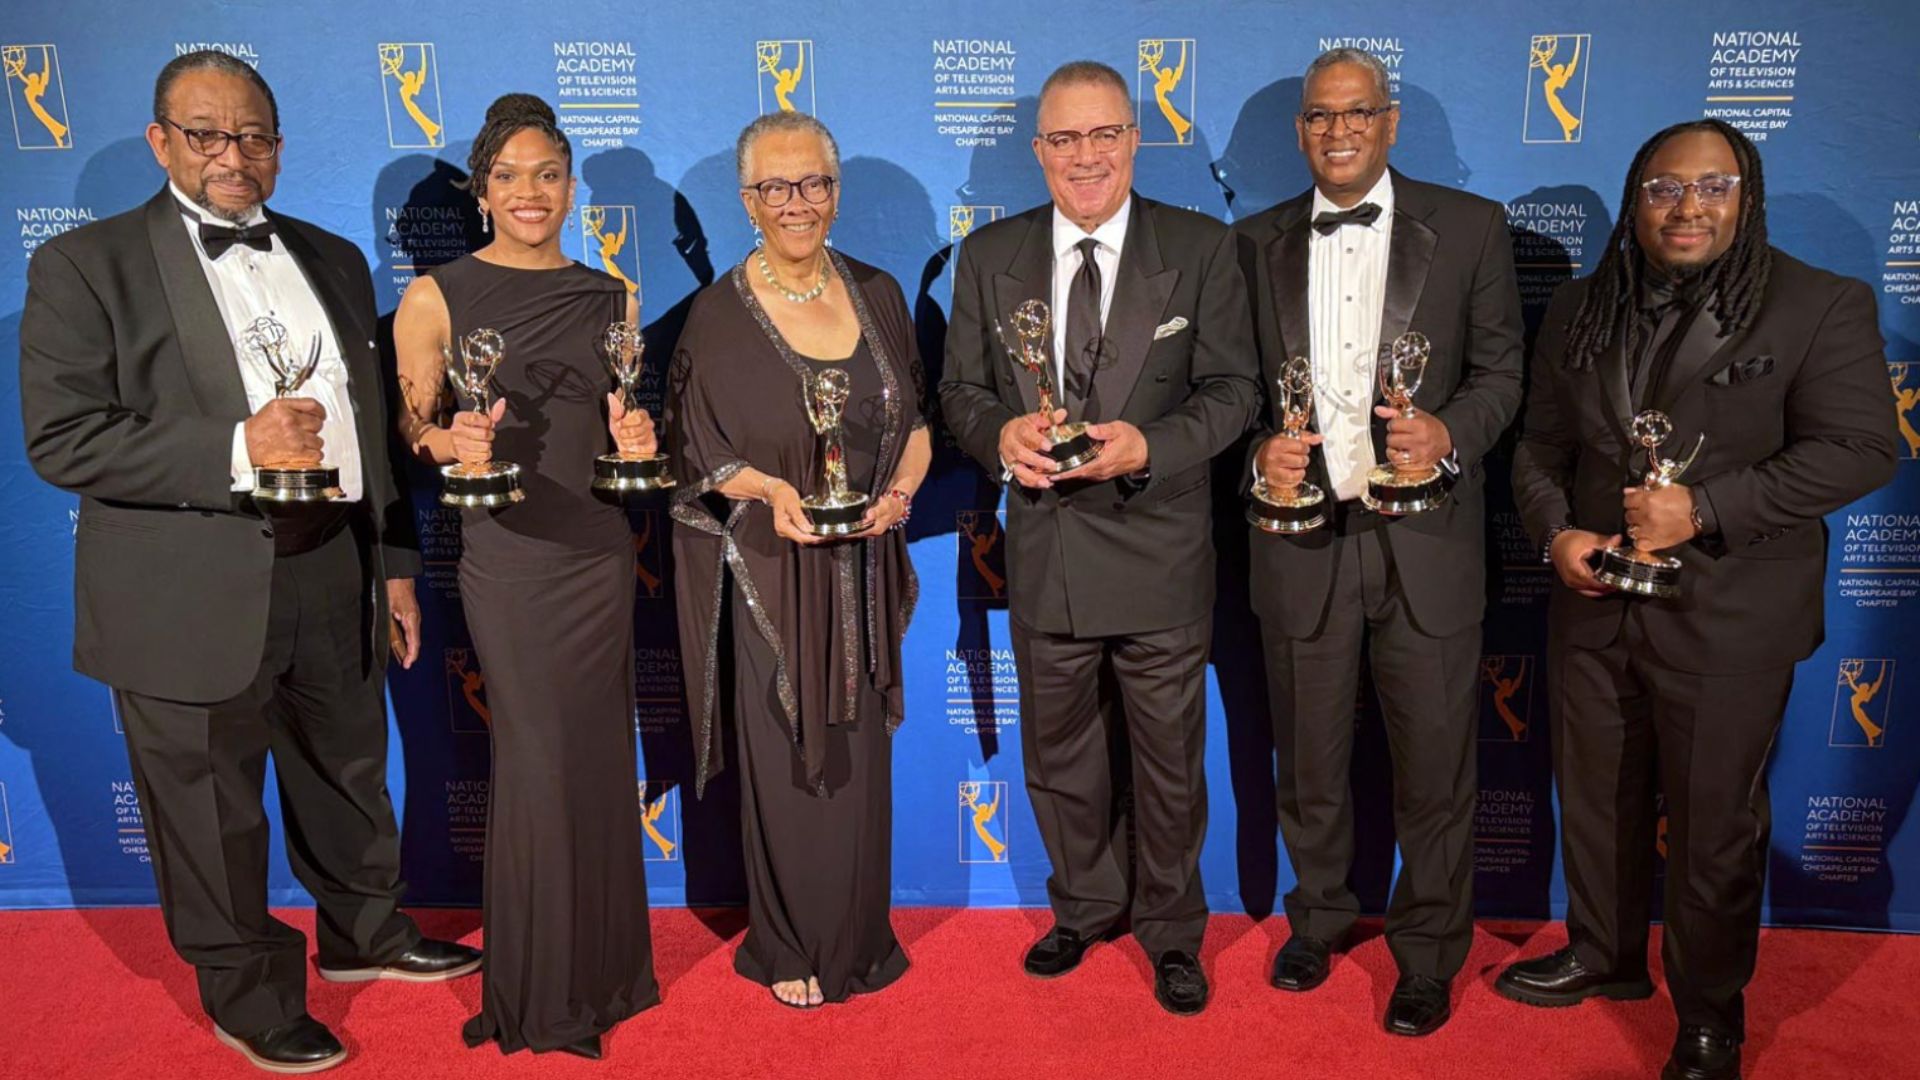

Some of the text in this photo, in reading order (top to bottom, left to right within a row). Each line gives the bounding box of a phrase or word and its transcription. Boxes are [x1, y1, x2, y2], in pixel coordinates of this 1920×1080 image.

[1713, 32, 1802, 46] NATIONAL
[554, 42, 636, 56] NATIONAL
[934, 40, 1016, 54] NATIONAL
[1320, 38, 1404, 51] NATIONAL
[1710, 49, 1800, 63] ACADEMY
[557, 59, 636, 72] ACADEMY
[935, 57, 1015, 70] ACADEMY
[1710, 67, 1796, 76] OF TELEVISION
[558, 76, 636, 85] OF TELEVISION
[935, 74, 1014, 84] OF TELEVISION
[1708, 80, 1794, 88] ARTS & SCIENCES
[560, 88, 637, 97] ARTS & SCIENCES
[936, 86, 1015, 95] ARTS & SCIENCES
[1704, 109, 1792, 117] NATIONAL CAPITAL
[1727, 121, 1788, 129] APEAKE BAY
[565, 127, 620, 135] CHESAPEAKE
[583, 138, 623, 147] CHAPTER
[956, 138, 996, 146] CHAPTER
[17, 208, 98, 221] NATIONAL
[386, 207, 464, 220] NATIONAL
[1504, 204, 1587, 217] NATIONAL
[21, 223, 79, 237] ACADE
[388, 222, 464, 236] ACADEMY
[1890, 234, 1906, 244] OF
[1888, 246, 1913, 254] ARTS
[1883, 273, 1920, 281] NATION
[1844, 544, 1860, 552] OF
[1838, 579, 1884, 587] NATIONAL
[1840, 589, 1898, 597] CHESAPEAKE
[947, 663, 1017, 673] ACADEMY
[947, 676, 960, 684] OF
[1808, 796, 1887, 809] NATIONAL
[116, 807, 129, 815] OF
[1807, 809, 1886, 822] ACADEMY
[1806, 822, 1883, 832] OF TELEVISION
[1839, 833, 1881, 841] SCIENCES
[1801, 855, 1880, 864] NATIONAL CAPITAL
[1803, 864, 1858, 872] CHESAPEAKE
[1818, 874, 1858, 882] CHAPTER
